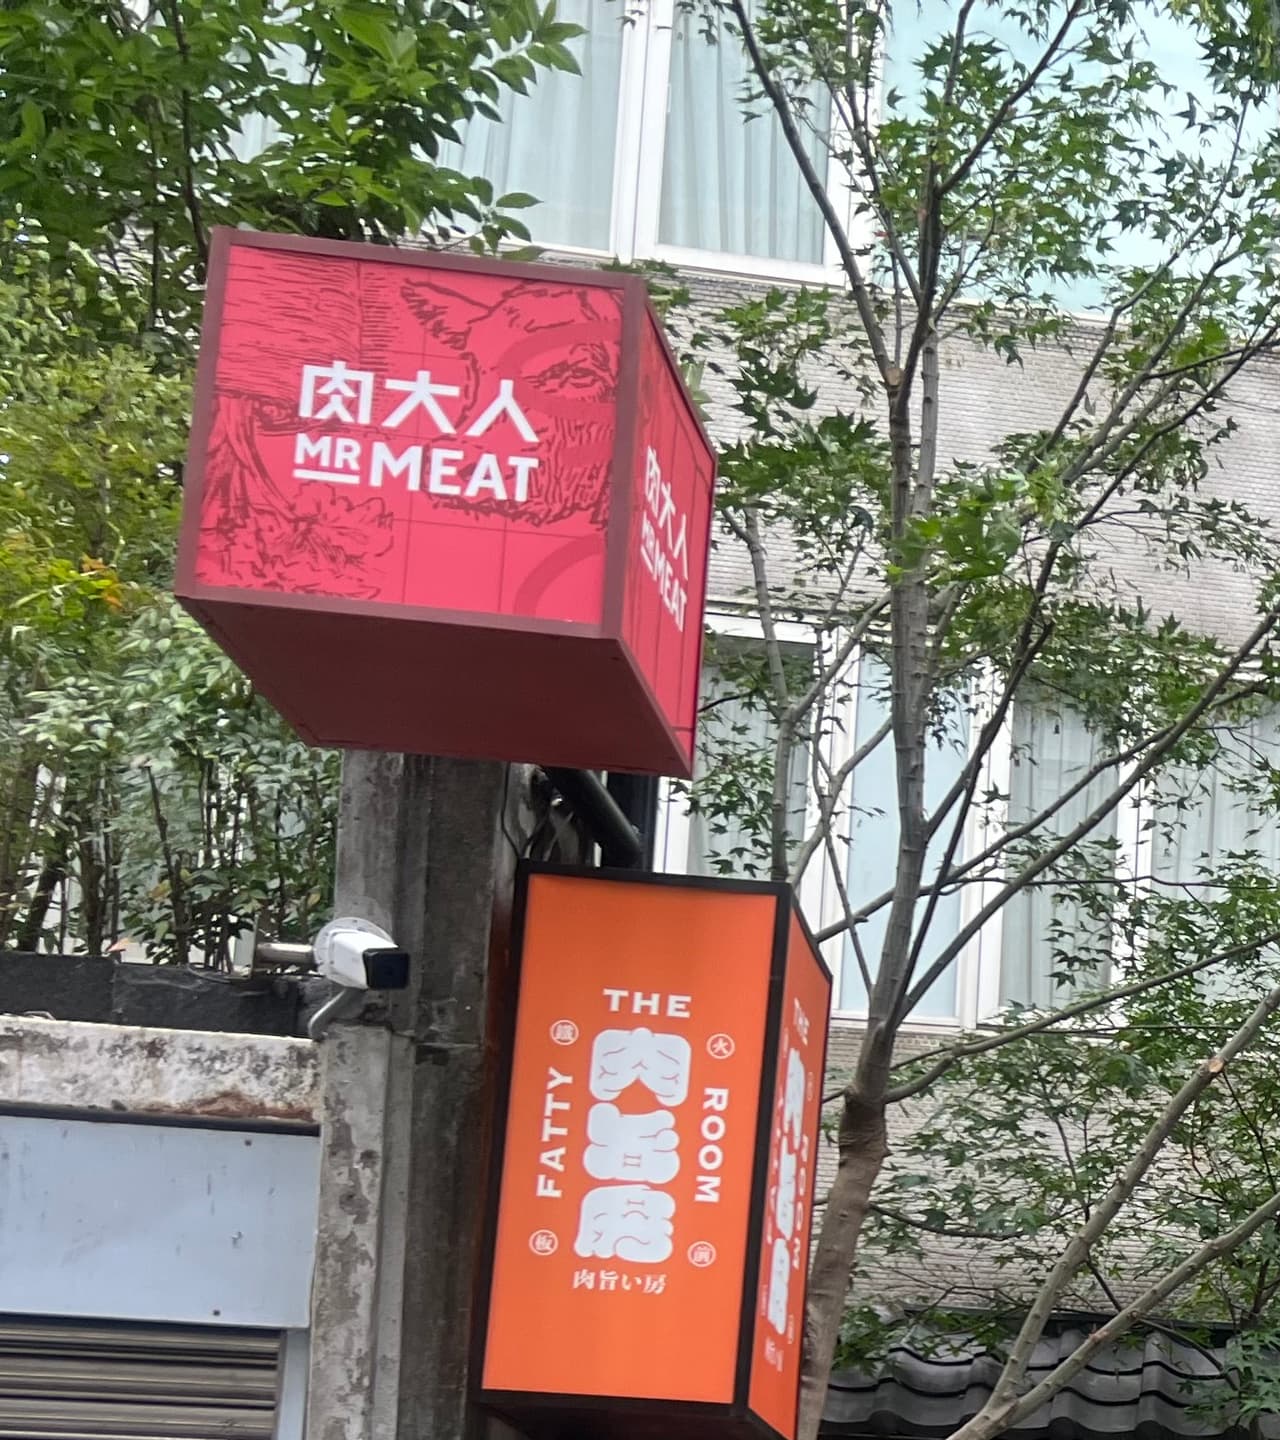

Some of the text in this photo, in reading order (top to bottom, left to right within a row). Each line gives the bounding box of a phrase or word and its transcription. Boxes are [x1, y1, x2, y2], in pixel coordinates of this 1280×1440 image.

[298, 360, 540, 443] 肉大人
[293, 432, 540, 503] MR MEAT
[644, 445, 688, 581] 肉大人
[653, 537, 688, 633] MEAT
[602, 988, 692, 1018] THE
[536, 1066, 574, 1199] FATTY
[694, 1087, 729, 1203] ROOM
[573, 1268, 667, 1295] 肉旨い房
